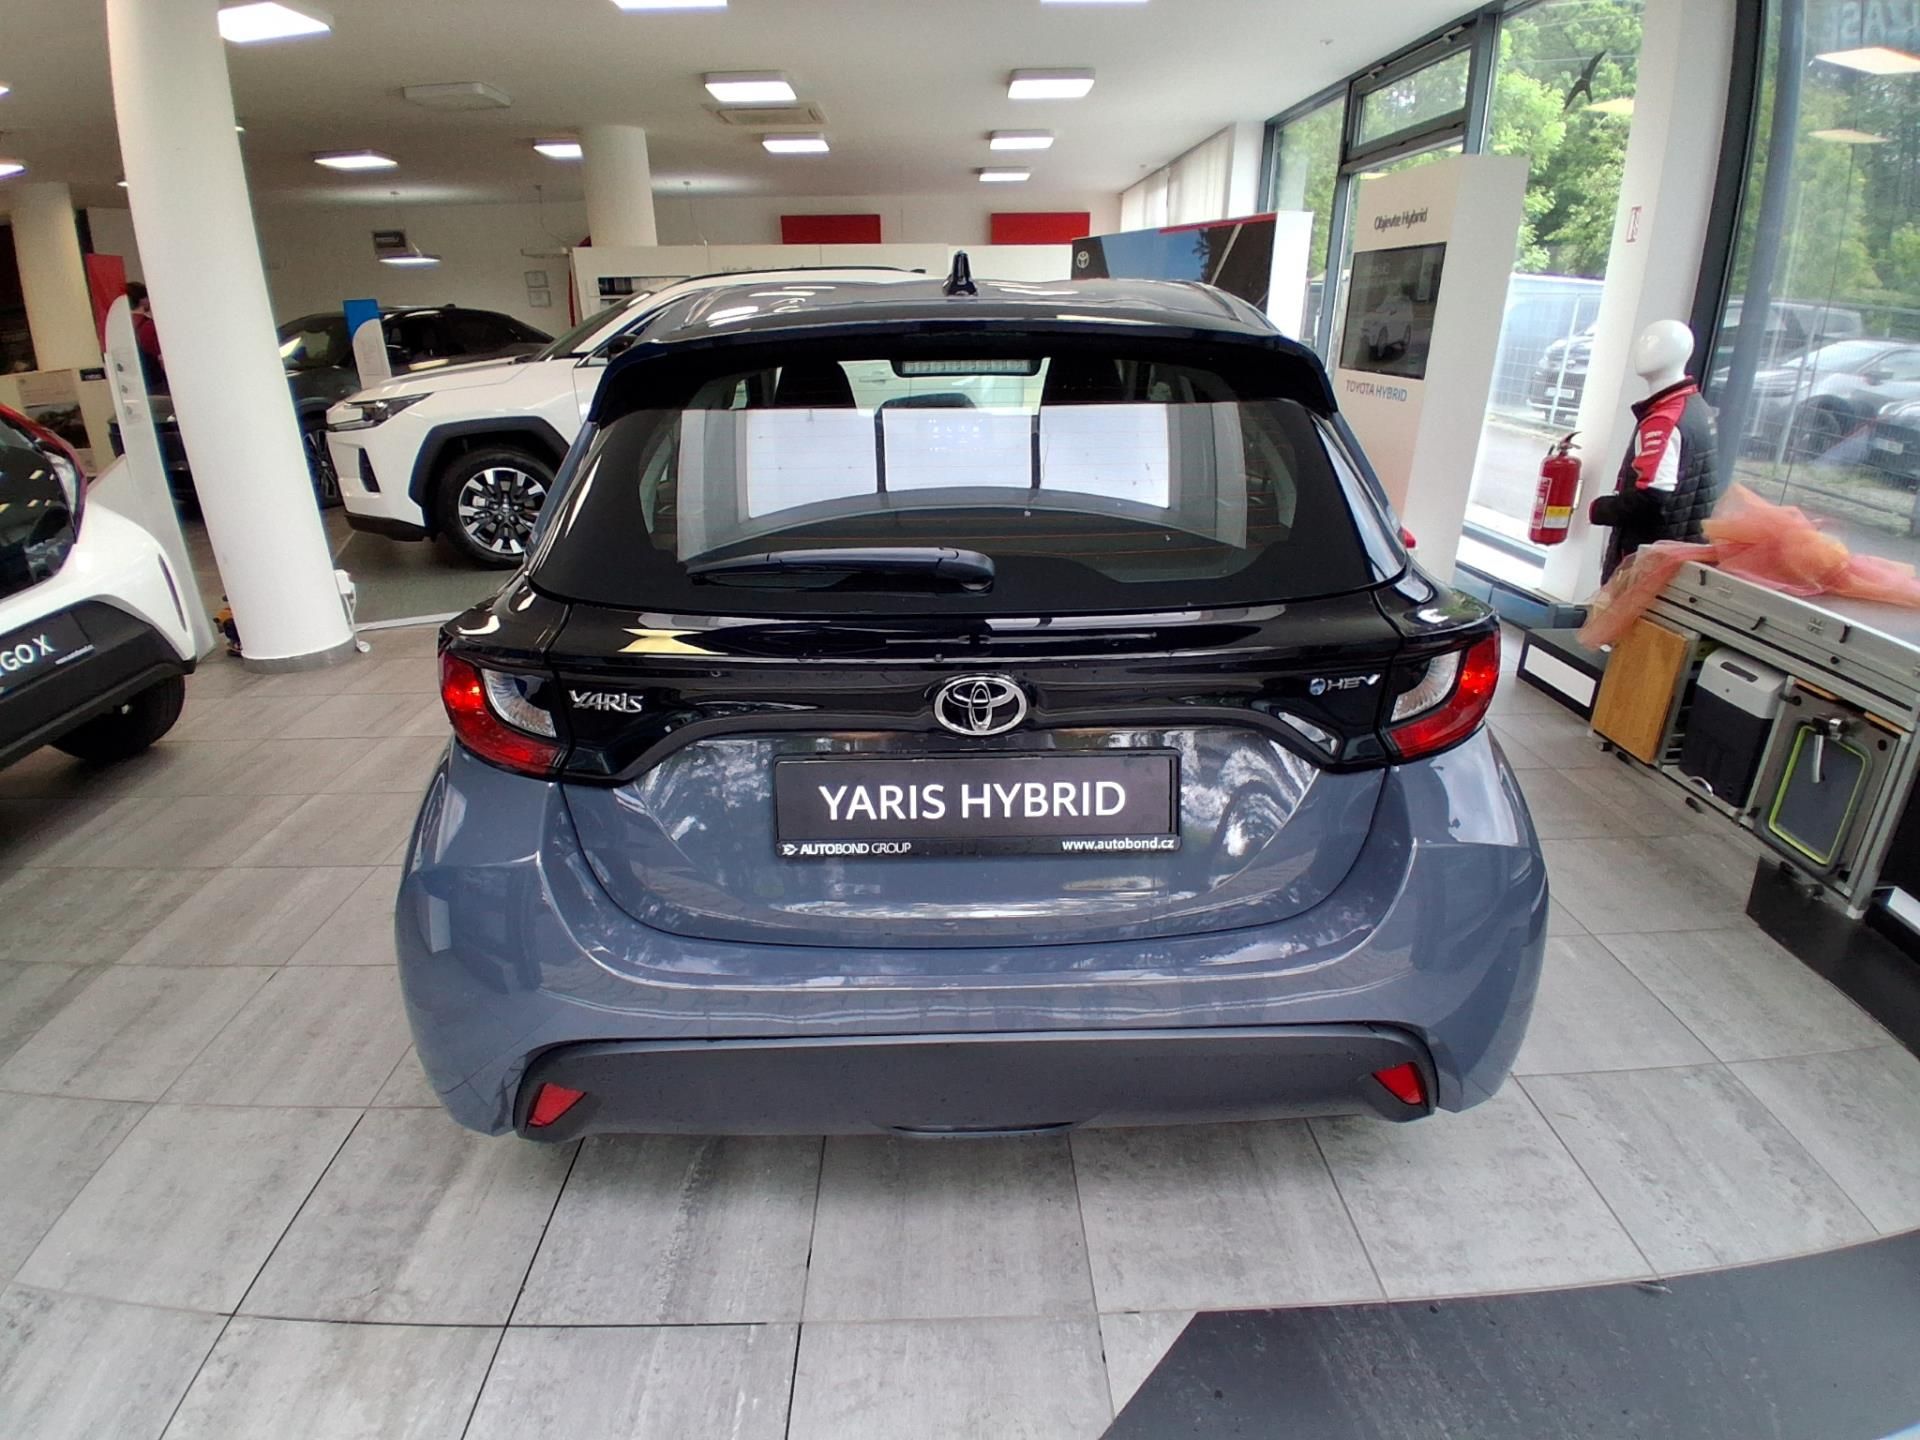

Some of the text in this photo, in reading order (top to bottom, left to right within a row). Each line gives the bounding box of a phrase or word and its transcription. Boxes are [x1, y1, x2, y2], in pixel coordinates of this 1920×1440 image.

[1346, 380, 1408, 402] TOYOTA HYBRID
[32, 634, 55, 657] X
[1326, 673, 1381, 692] HEV
[819, 781, 1127, 820] YARIS HYBRID
[800, 842, 912, 856] AUTOBOND GROUP
[1061, 836, 1175, 851] www.autobond.cz
